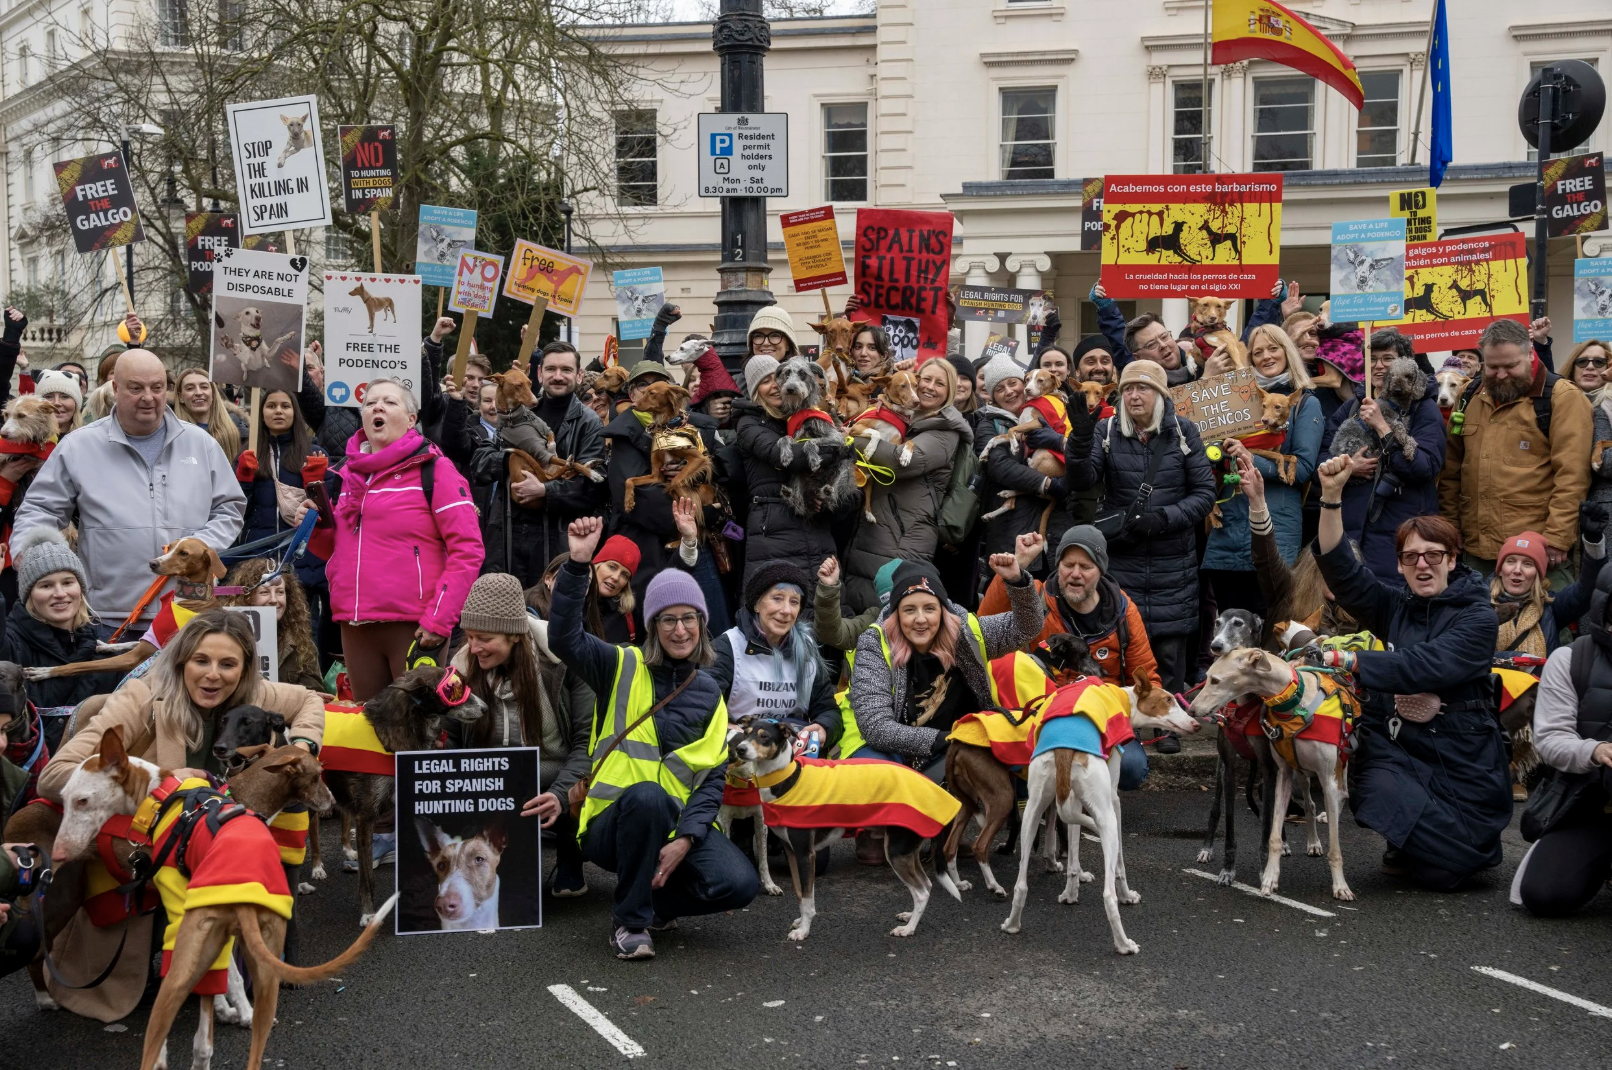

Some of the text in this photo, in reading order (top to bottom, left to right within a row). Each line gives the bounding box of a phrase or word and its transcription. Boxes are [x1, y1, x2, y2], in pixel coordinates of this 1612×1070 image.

[244, 140, 272, 159] STOP
[716, 136, 729, 154] P
[356, 142, 383, 168] NO
[247, 162, 268, 179] THE
[75, 179, 118, 201] FREE
[250, 176, 308, 199] KILLING IN
[1109, 184, 1164, 192] Acabemos
[1215, 183, 1277, 192] barbarismo
[1557, 176, 1593, 194] FREE
[352, 188, 392, 199] IN SPAIN
[1399, 191, 1426, 211] NO
[1566, 192, 1586, 203] THE
[88, 198, 111, 211] THE
[253, 202, 288, 221] SPAIN
[1552, 200, 1602, 218] GALGO
[76, 207, 131, 230] GALGO
[1407, 216, 1431, 226] NTING
[198, 236, 228, 249] FREE
[862, 226, 947, 255] SPAIN'S
[1409, 246, 1436, 256] galgos
[1446, 241, 1489, 253] podencos
[522, 249, 554, 274] free
[1405, 257, 1430, 266] mbién
[1450, 251, 1492, 262] animales!
[223, 266, 299, 282] THEY ARE NOT
[458, 255, 499, 282] NO
[861, 255, 946, 284] FILTHY
[227, 282, 293, 297] DISPOSABLE
[467, 280, 493, 292] hunting
[514, 281, 535, 292] hunting
[557, 295, 572, 304] Spain
[1170, 283, 1189, 291] lugar
[1210, 283, 1227, 291] siglo
[458, 289, 489, 301] with dogs
[860, 281, 942, 315] SECRET
[961, 291, 1023, 302] LEGAL RIGHTS FOR
[1334, 297, 1350, 306] Hope
[1367, 295, 1400, 303] Podencos
[466, 299, 485, 310] Spain
[346, 343, 400, 353] FREE THE
[922, 336, 937, 350] die
[989, 342, 1011, 355] LEGAL
[339, 358, 407, 370] PODENCO'S
[1192, 383, 1231, 403] SAVE
[1201, 400, 1230, 417] THE
[759, 681, 797, 692] IBIZAN
[757, 698, 796, 708] HOUND
[415, 758, 509, 773] LEGAL RIGHTS
[415, 778, 504, 794] FOR SPANISH
[415, 798, 515, 814] HUNTING DOGS
